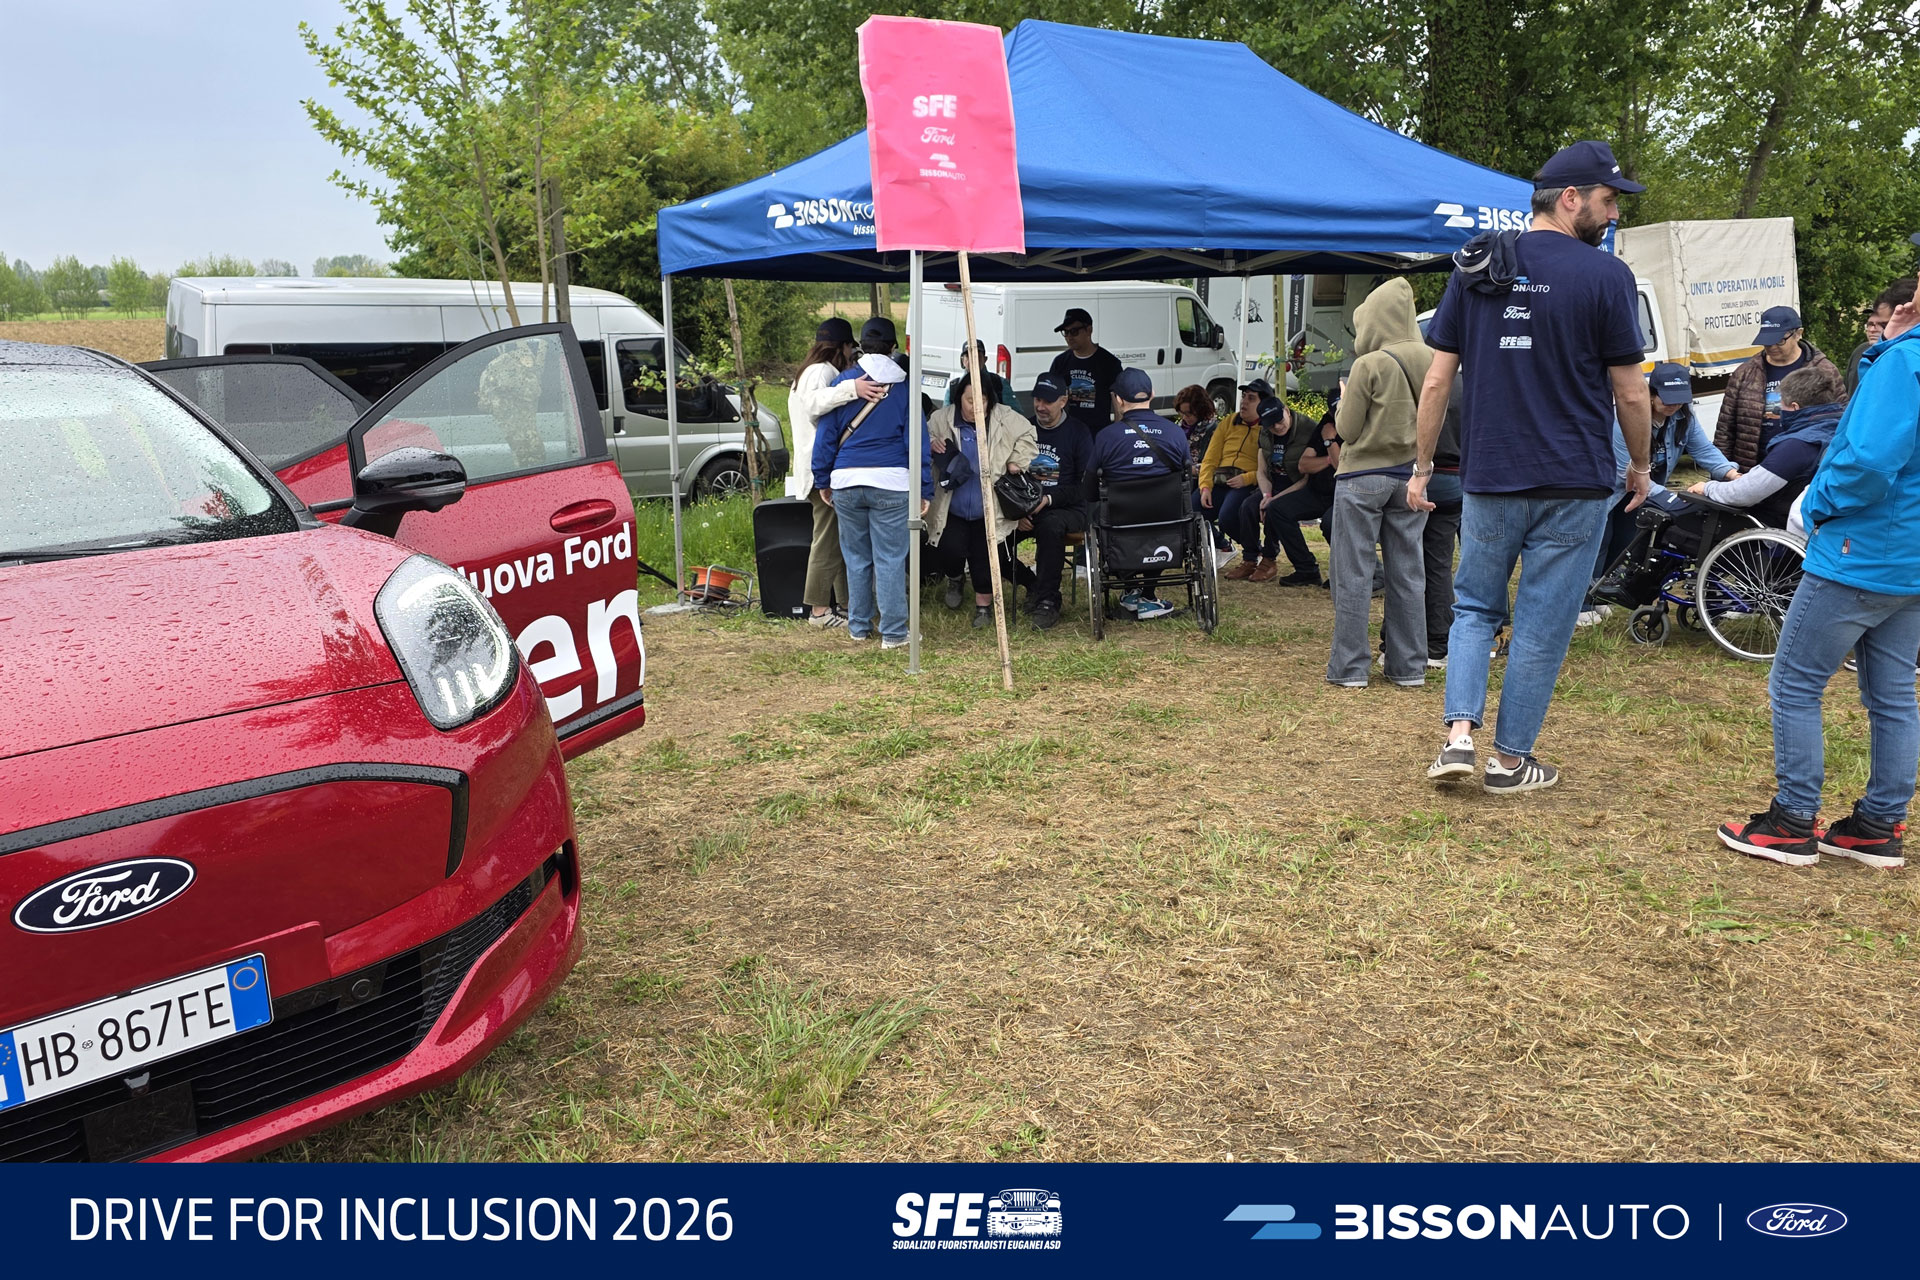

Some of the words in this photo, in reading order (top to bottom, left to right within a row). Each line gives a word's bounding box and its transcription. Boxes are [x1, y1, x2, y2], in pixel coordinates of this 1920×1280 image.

[912, 95, 957, 118] SFE
[921, 127, 955, 146] Ford
[919, 168, 966, 181] BISSONAUTO
[793, 198, 875, 227] BISSONAU
[853, 224, 877, 236] bisso
[1512, 284, 1551, 293] ONAUTO
[1717, 278, 1759, 294] OPERATIVA
[1760, 275, 1785, 290] MOBILE
[1503, 305, 1532, 320] Ford
[1721, 301, 1739, 310] COMUNE
[1740, 300, 1745, 308] DI
[1745, 299, 1760, 308] PADOVA
[1705, 312, 1752, 330] PROTEZIONE
[1500, 336, 1518, 347] SFE
[1071, 374, 1096, 384] CLUSION
[457, 552, 555, 600] uova
[563, 521, 632, 576] Ford
[515, 589, 646, 723] en
[53, 869, 161, 924] Ford
[20, 1030, 79, 1086] HB
[97, 982, 231, 1062] 867FE
